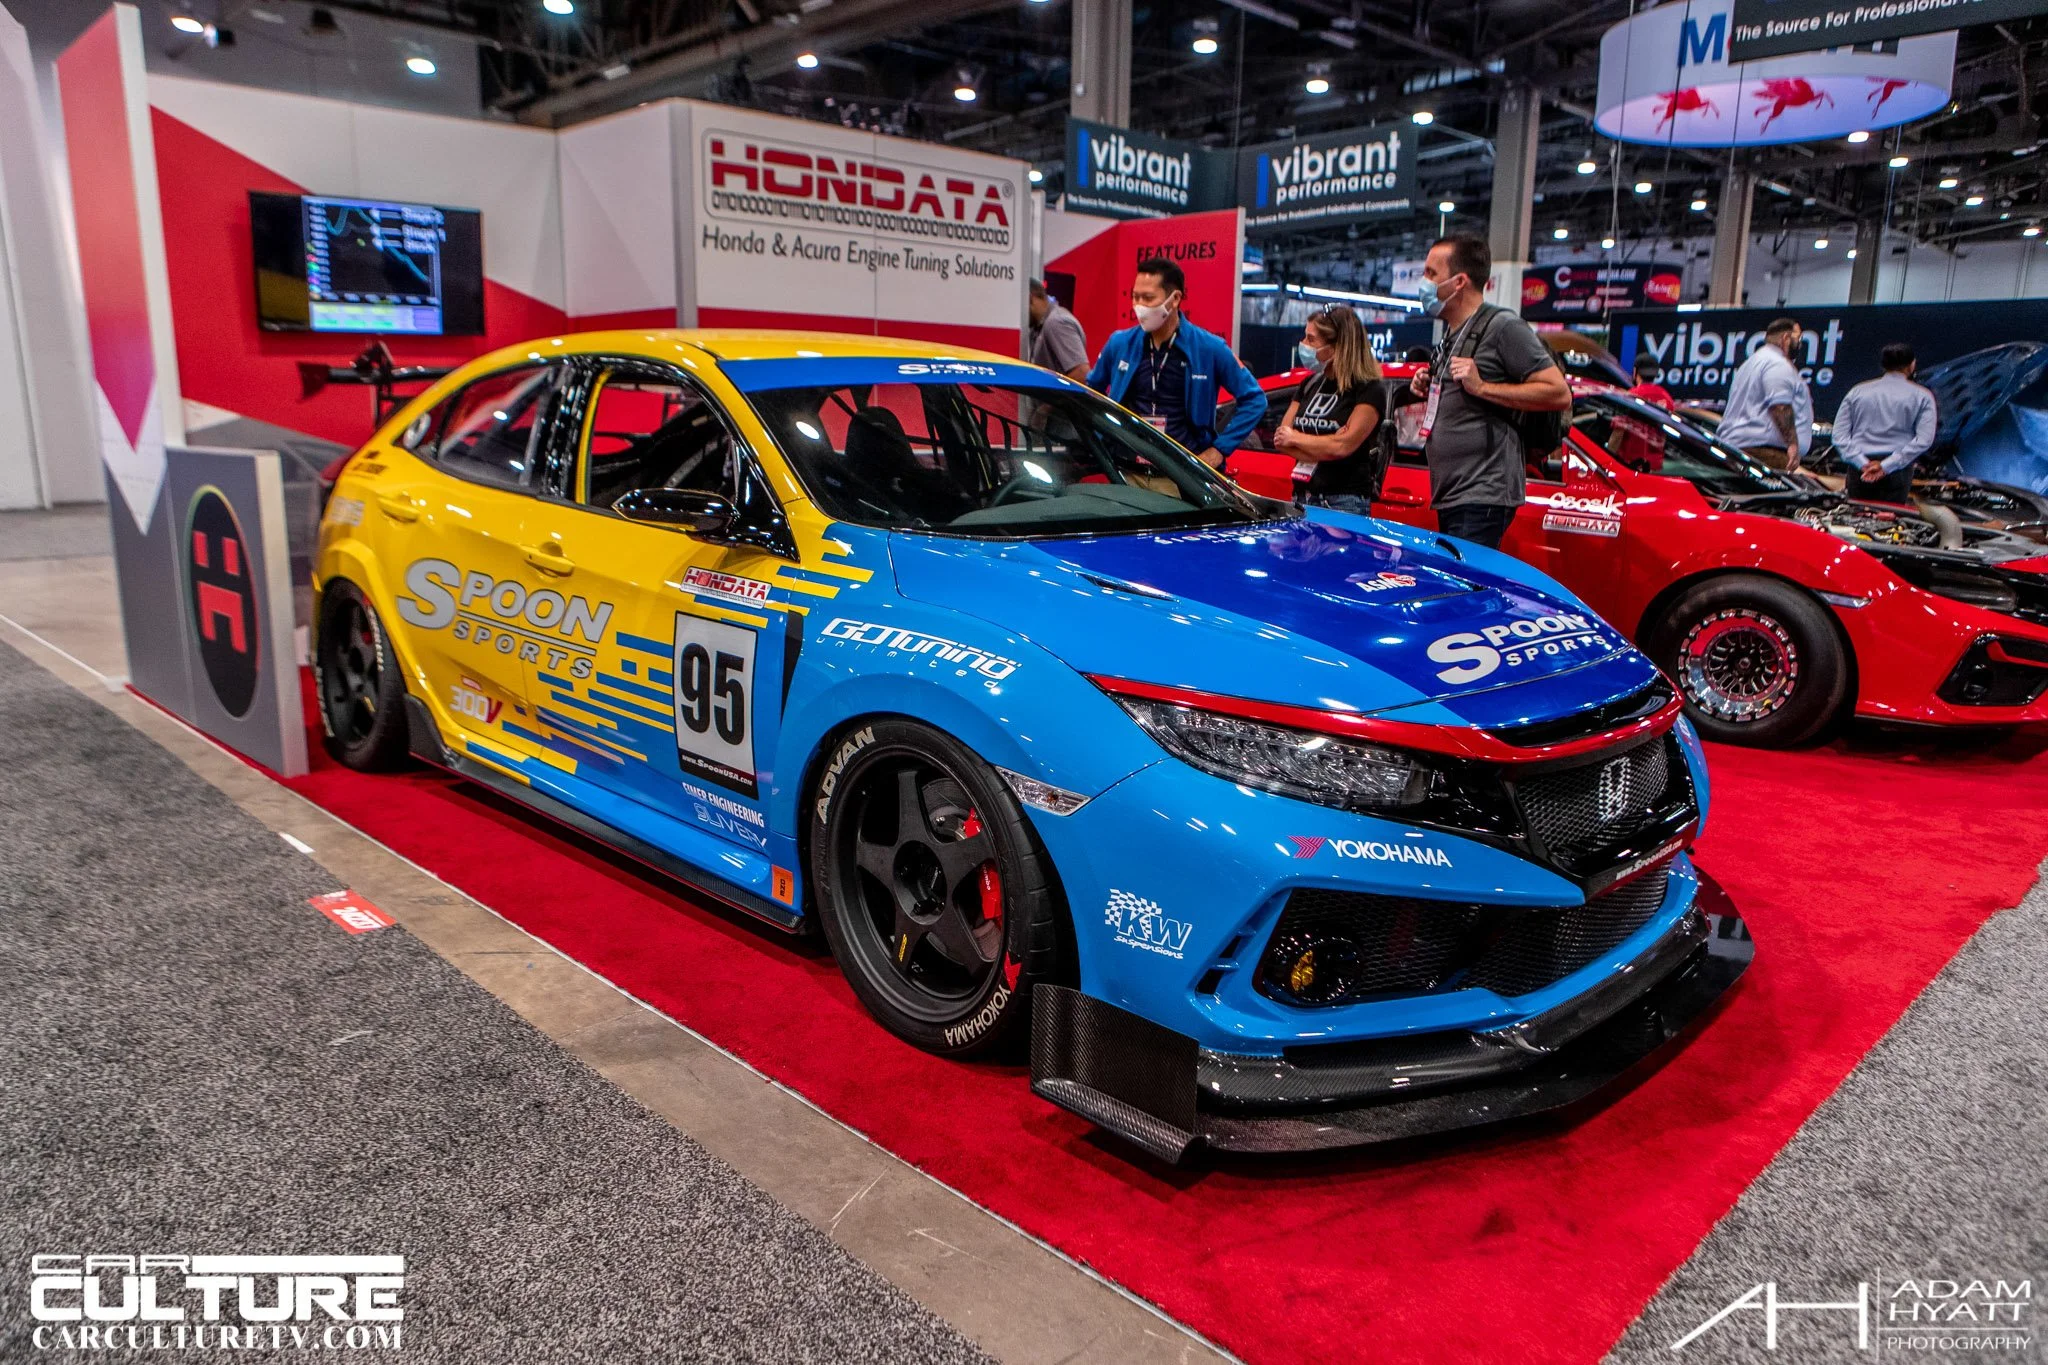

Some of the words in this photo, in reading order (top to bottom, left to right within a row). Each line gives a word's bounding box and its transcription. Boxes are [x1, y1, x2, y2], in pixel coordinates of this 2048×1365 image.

[1736, 25, 1761, 43] The
[1766, 16, 1820, 39] Source
[1826, 10, 1852, 29] For
[1854, 0, 1957, 24] Professiona
[1091, 133, 1191, 188] vibrant
[1272, 131, 1401, 185] vibrant
[711, 139, 1009, 227] HONDATA
[1096, 170, 1188, 206] performance
[1276, 172, 1396, 206] performance
[702, 225, 764, 255] Honda
[772, 232, 787, 256] &
[792, 235, 841, 262] Acura
[847, 240, 900, 273] Engine
[903, 247, 949, 280] Tuning
[955, 254, 1015, 282] Solutions
[1136, 241, 1217, 265] FEATURES
[396, 557, 614, 643] SPOON
[684, 569, 767, 601] HONDATA
[453, 620, 594, 679] SPORTS
[816, 636, 999, 690] unlimited
[1427, 613, 1592, 686] SPOON
[1506, 634, 1607, 667] SPORTS
[449, 684, 503, 724] 300V
[681, 642, 745, 746] 95
[816, 726, 876, 825] ADVAN
[707, 792, 765, 828] ENGINEERING
[1327, 838, 1454, 868] YOKOHAMA
[1114, 934, 1184, 960] suspensions
[1117, 906, 1193, 951] KW
[944, 984, 1011, 1047] YOKOHAMA
